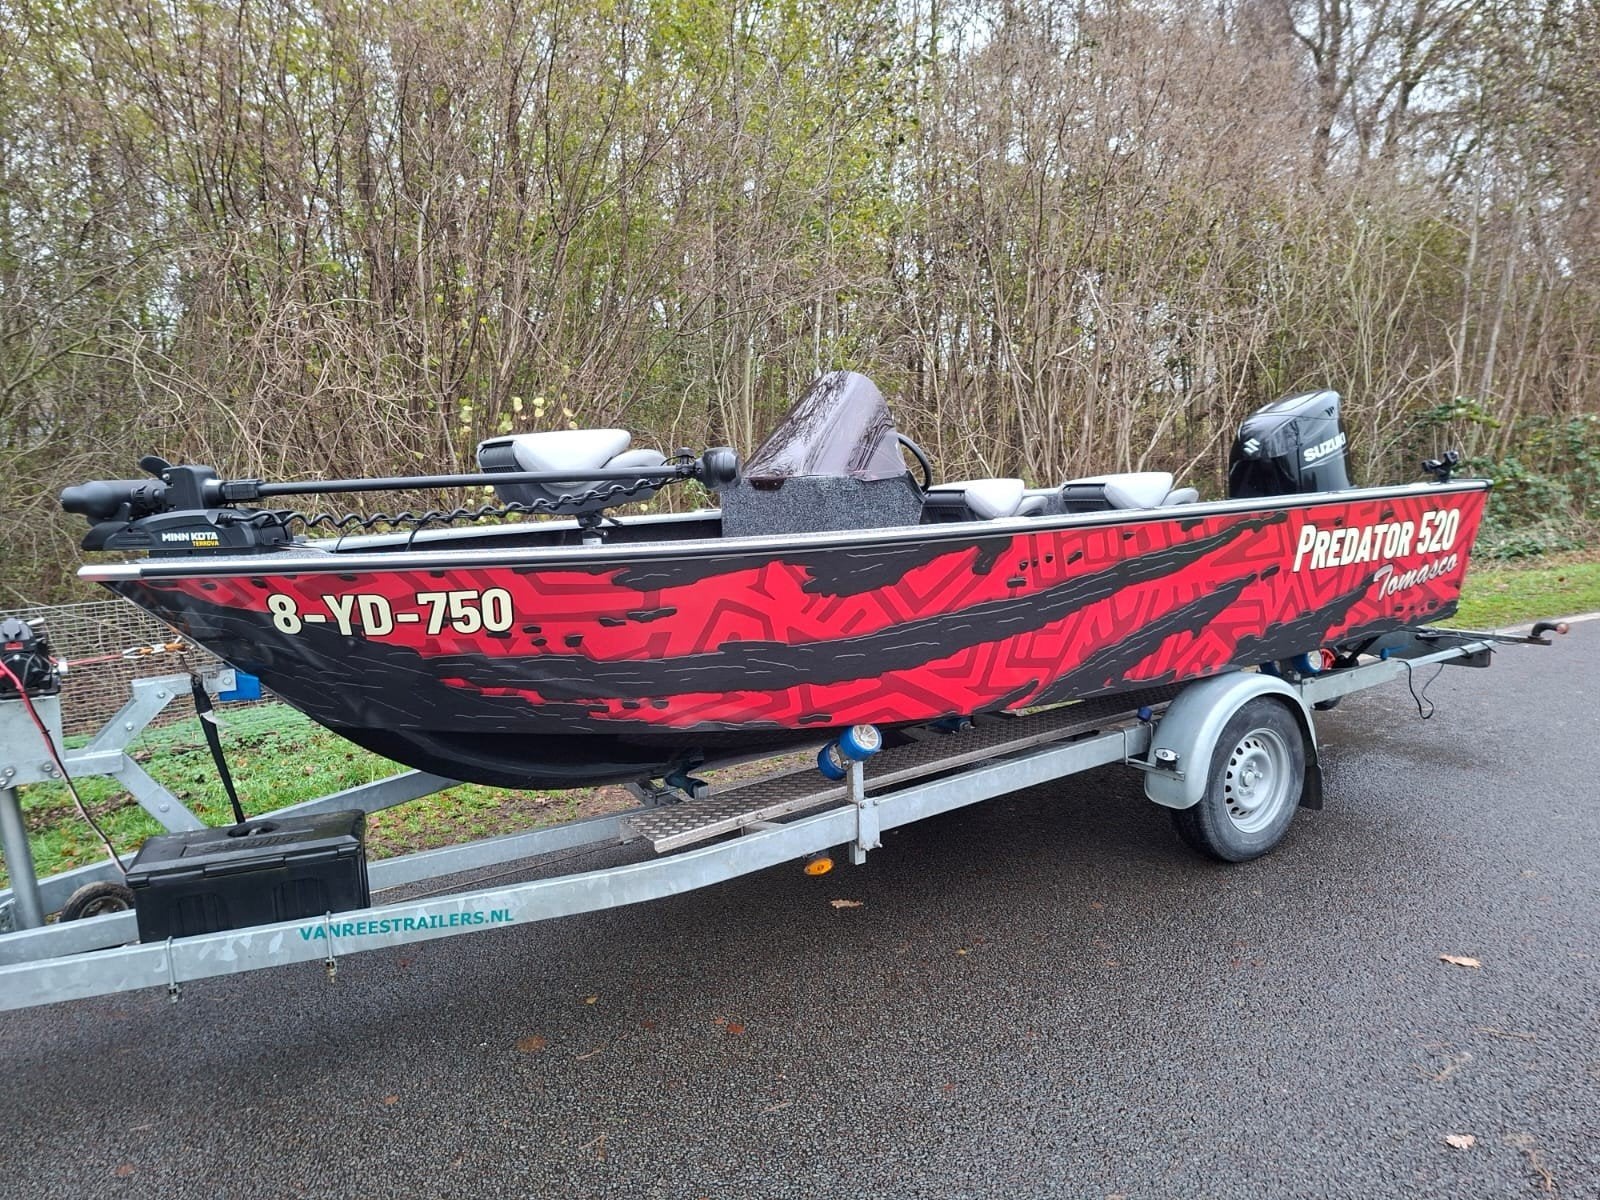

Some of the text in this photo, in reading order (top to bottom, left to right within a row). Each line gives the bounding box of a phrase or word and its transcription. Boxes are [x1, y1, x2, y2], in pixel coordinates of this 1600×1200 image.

[161, 531, 219, 542] MINN KOTA
[1416, 508, 1460, 555] 520
[1373, 552, 1459, 601] Tomasco
[266, 587, 514, 636] 8-YD-750
[299, 908, 515, 941] VANREESTRAILERS.NL
